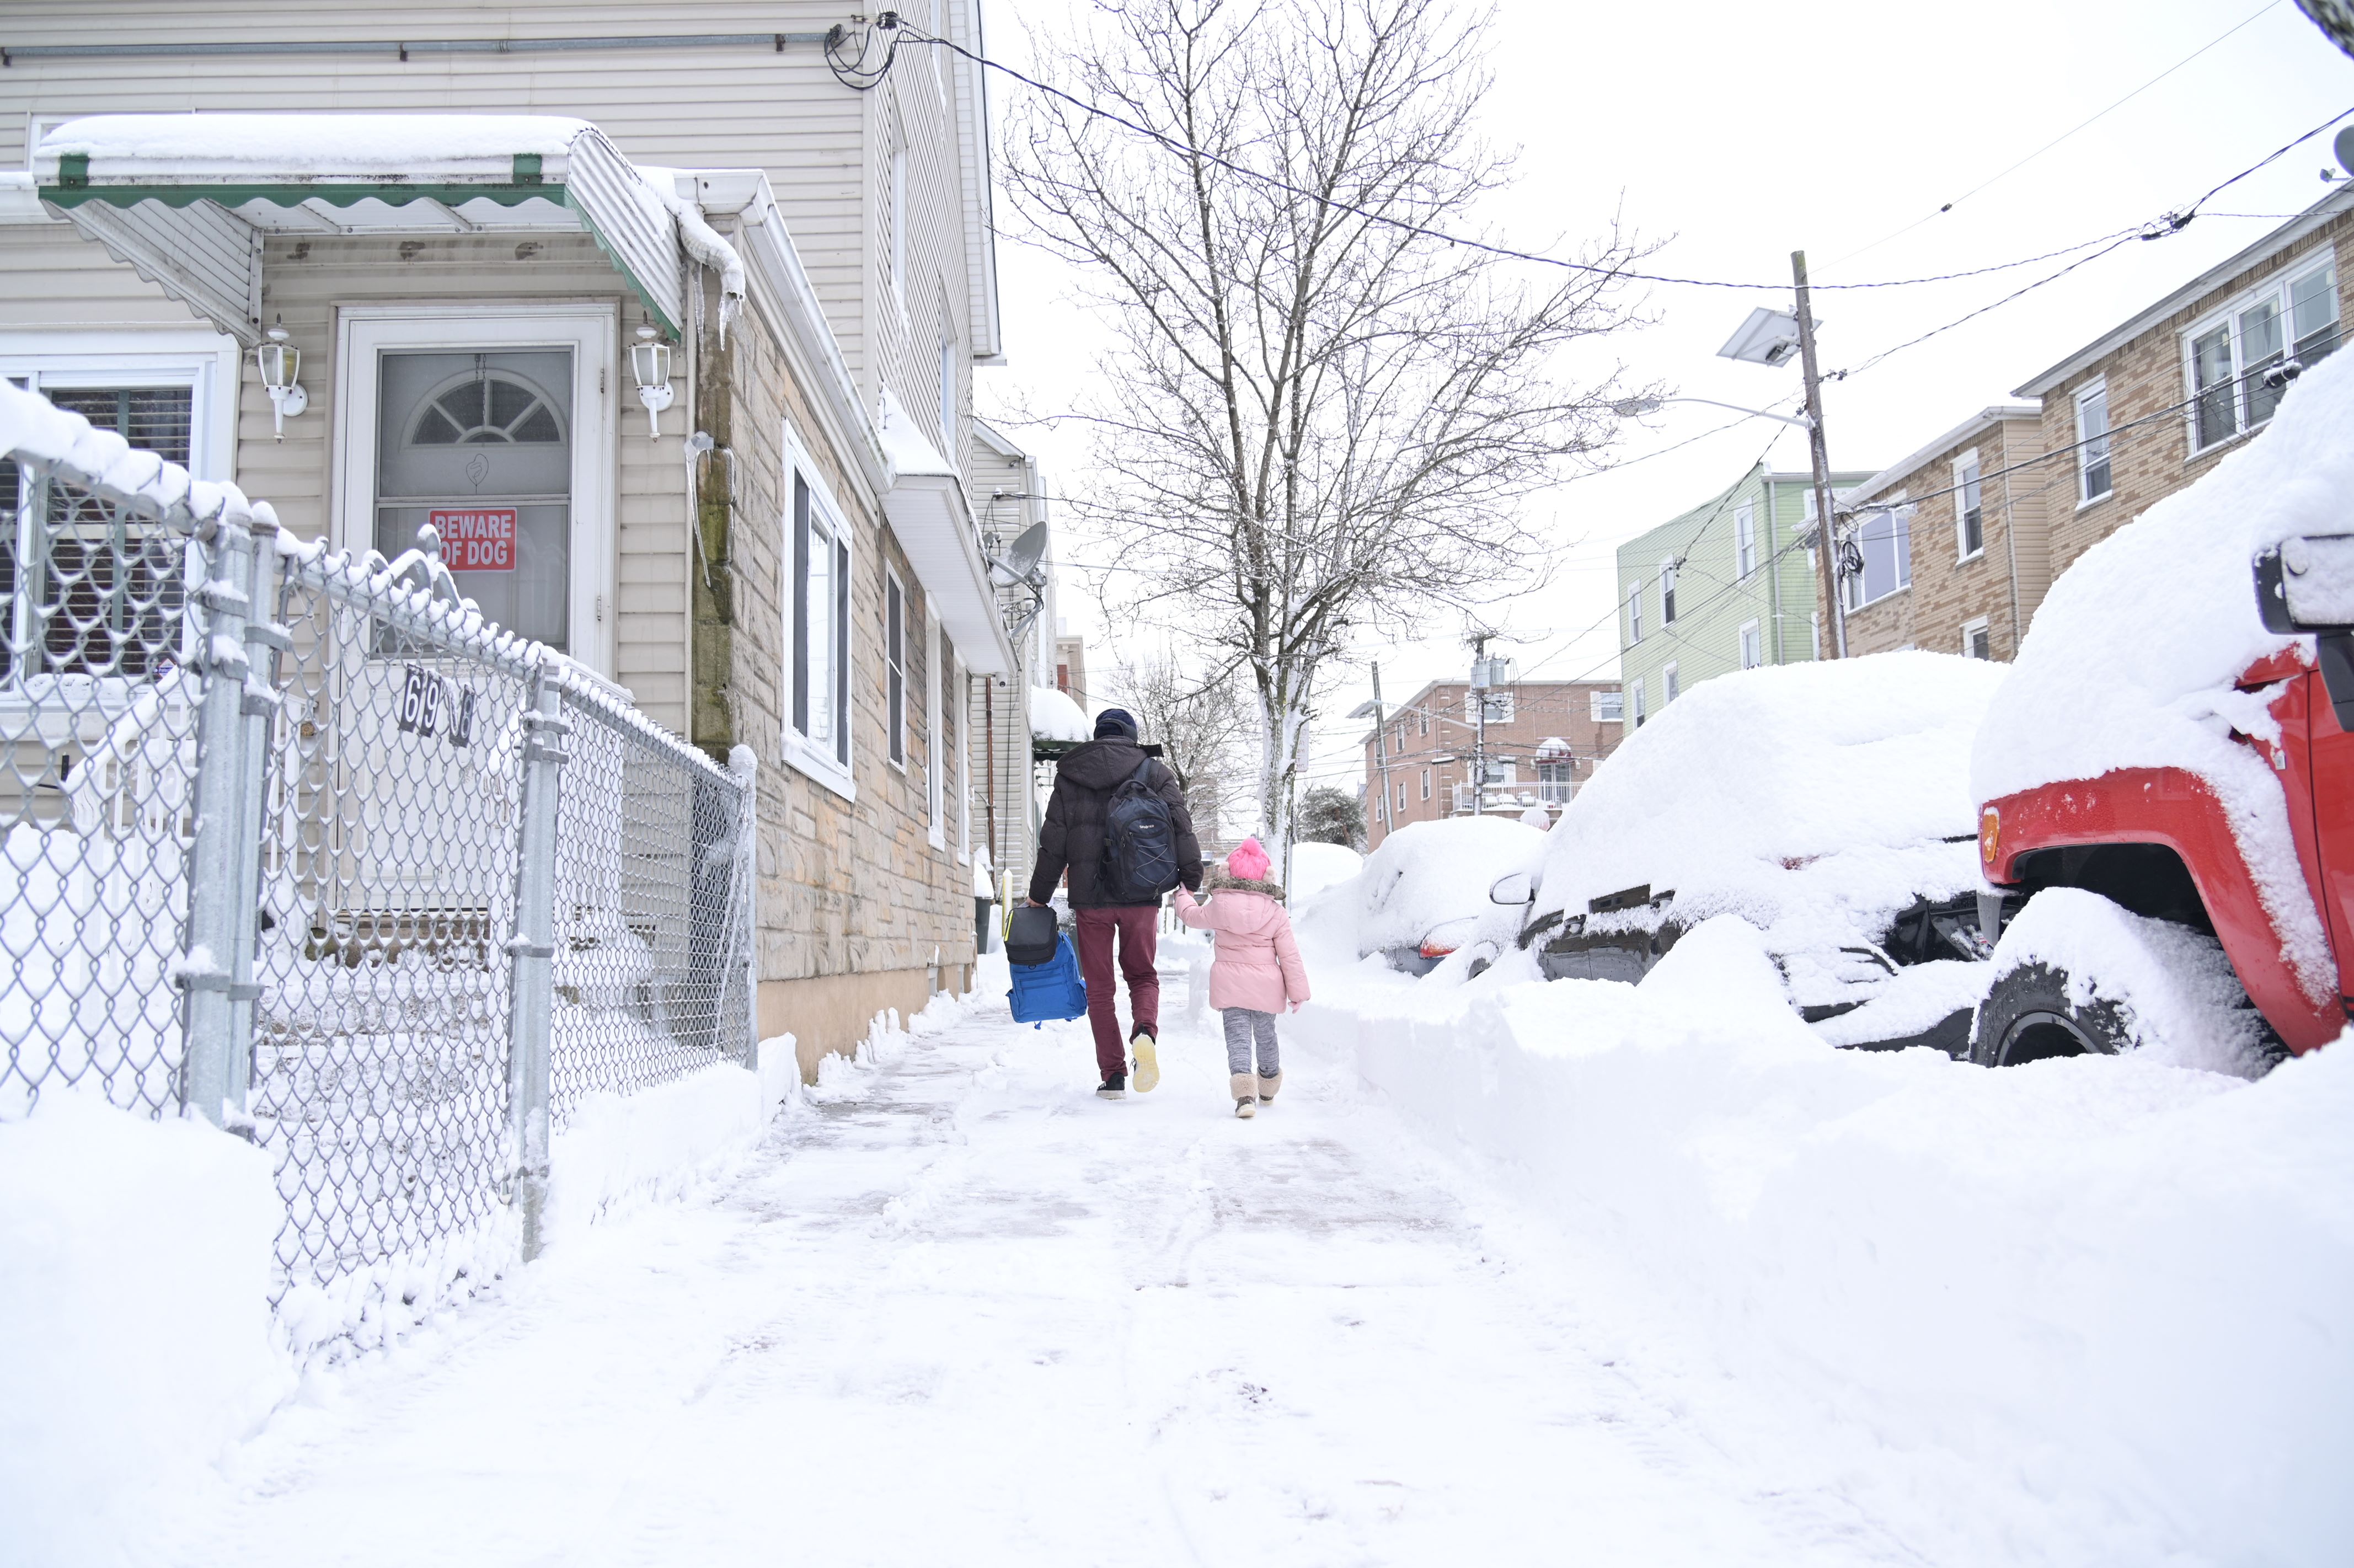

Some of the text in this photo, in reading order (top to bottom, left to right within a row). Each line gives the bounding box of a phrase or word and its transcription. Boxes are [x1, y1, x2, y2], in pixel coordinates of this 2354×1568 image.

[435, 515, 512, 539] BEWARE
[440, 540, 508, 565] OF DOG
